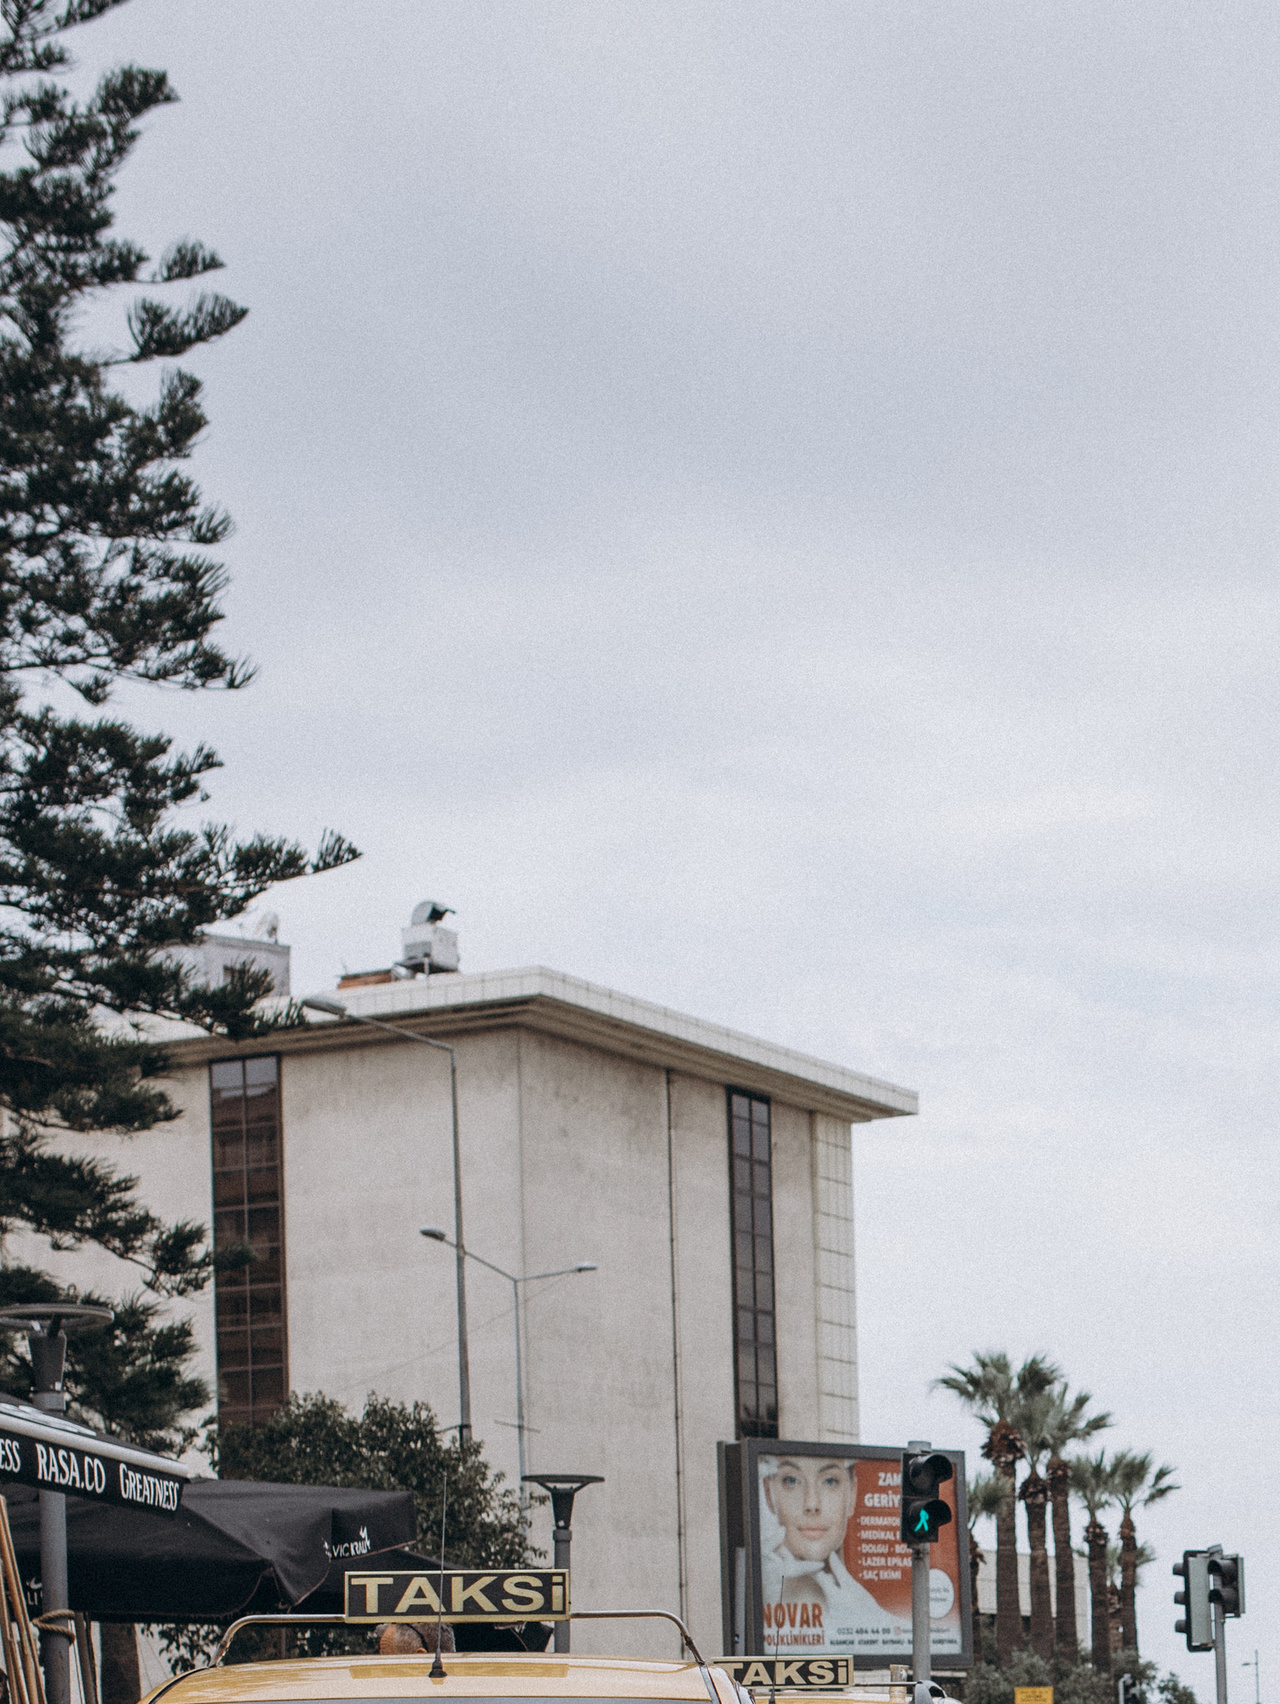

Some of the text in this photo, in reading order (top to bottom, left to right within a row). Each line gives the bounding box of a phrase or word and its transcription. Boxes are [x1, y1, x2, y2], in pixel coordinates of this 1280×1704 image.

[35, 1443, 106, 1494] RASA.CO
[119, 1463, 179, 1511] GREATNESS
[763, 1602, 823, 1629] NOVAR
